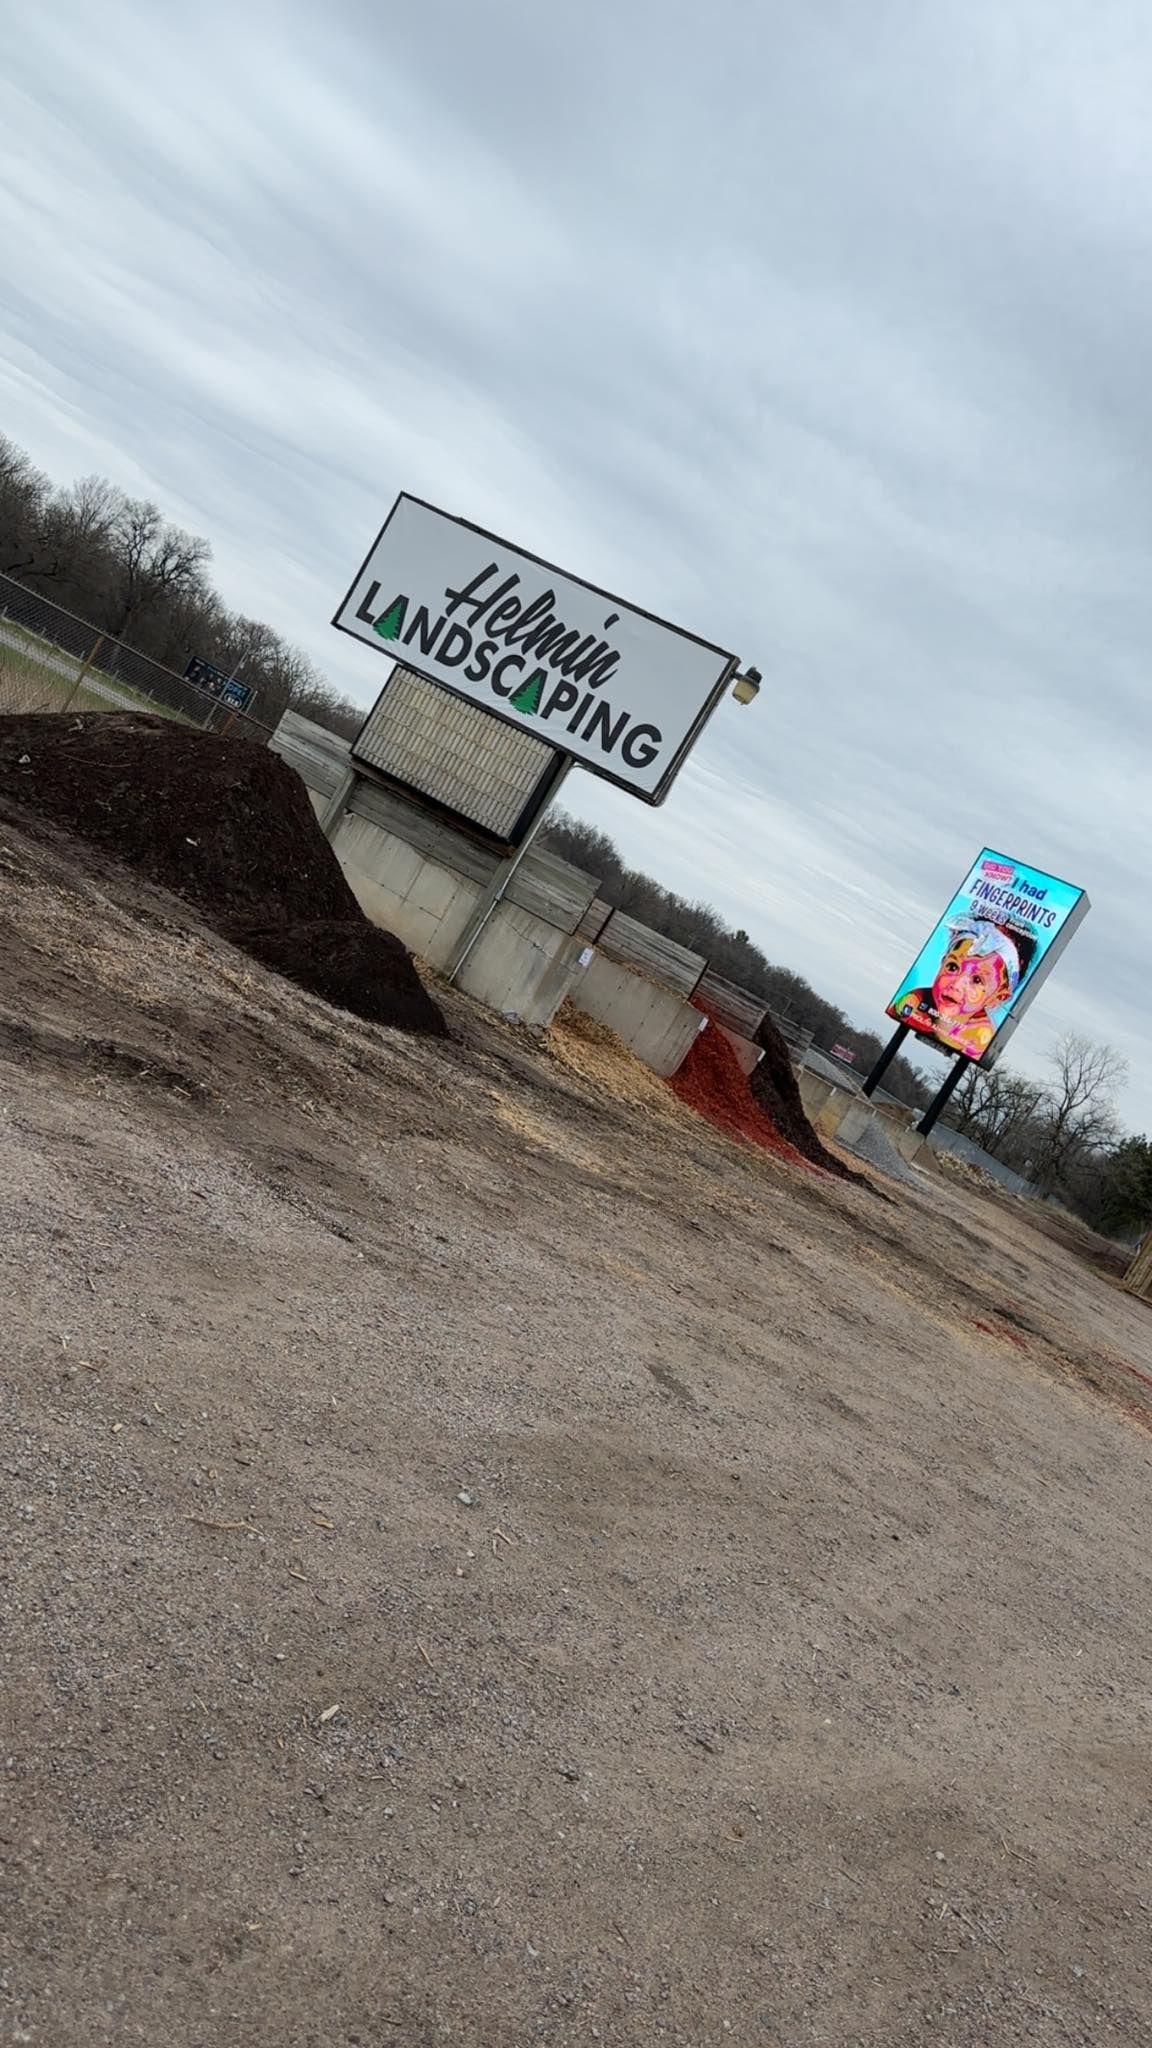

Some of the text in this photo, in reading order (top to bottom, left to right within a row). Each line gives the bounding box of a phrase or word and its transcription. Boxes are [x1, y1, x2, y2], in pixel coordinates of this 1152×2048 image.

[443, 562, 621, 689] Helmin
[354, 580, 663, 768] LANDSCAPING
[969, 878, 1056, 928] FINGERPRINTS
[969, 899, 1007, 924] 9 weeks
[1011, 877, 1048, 901] I had
